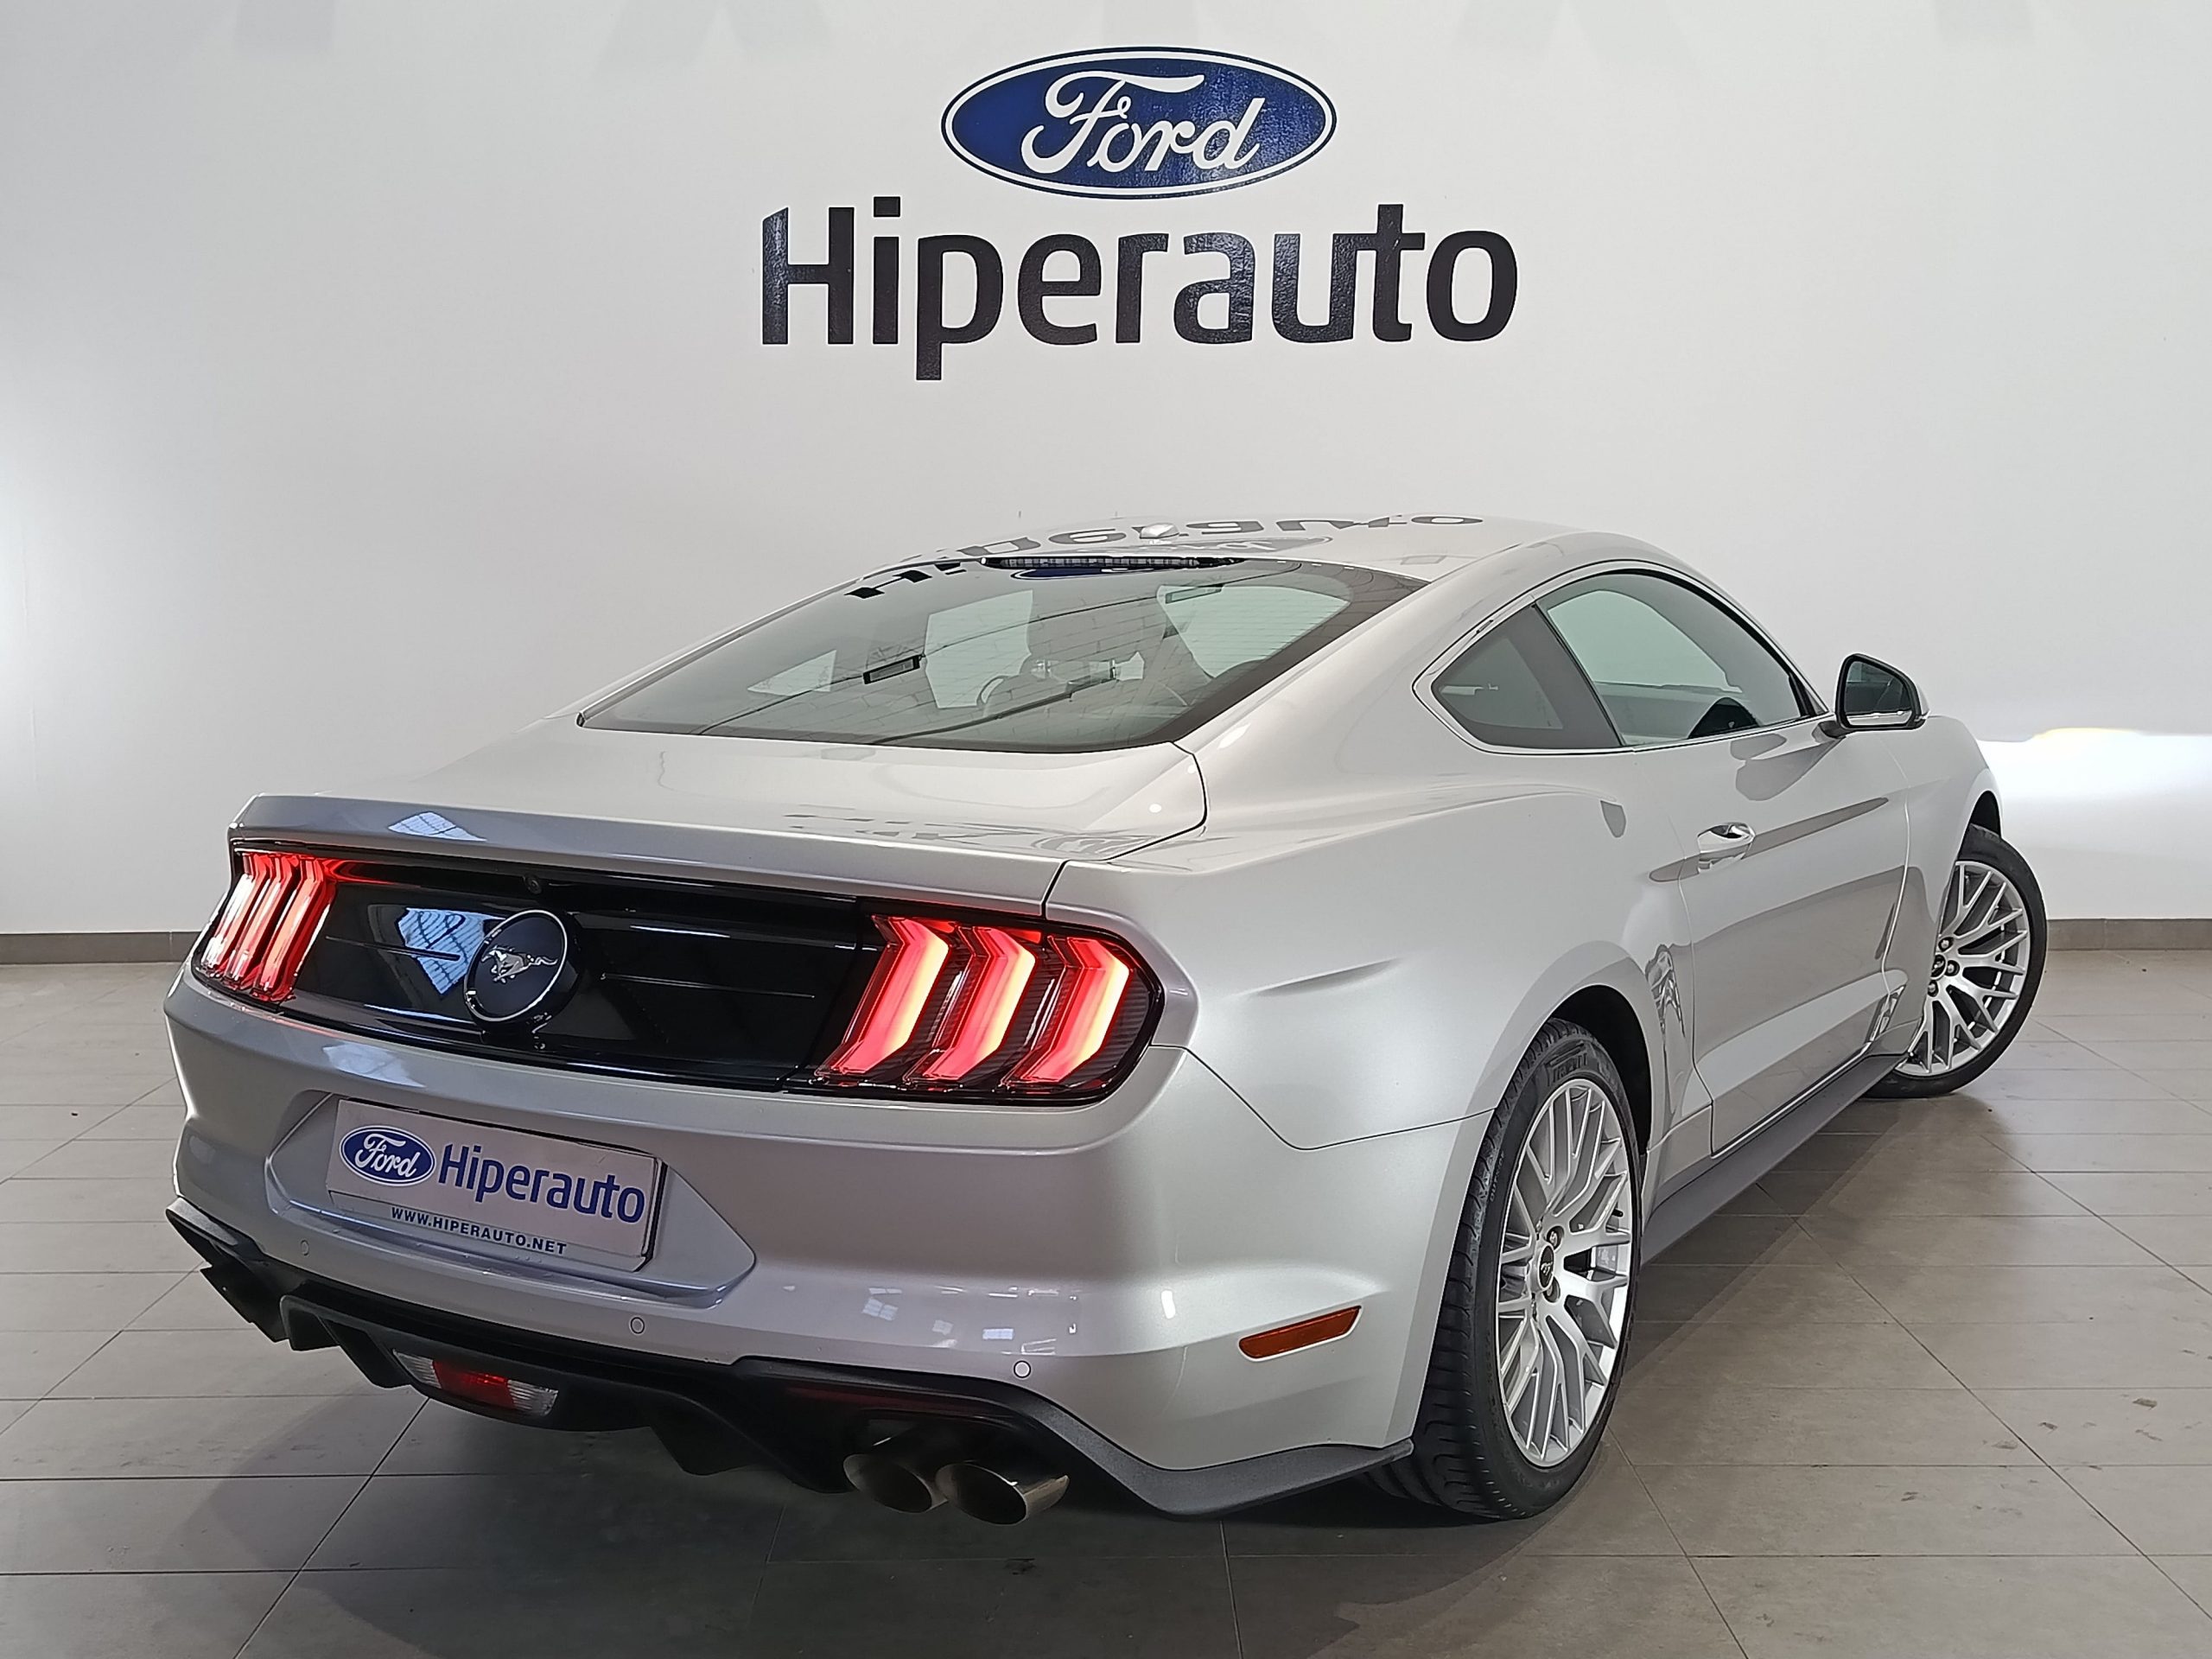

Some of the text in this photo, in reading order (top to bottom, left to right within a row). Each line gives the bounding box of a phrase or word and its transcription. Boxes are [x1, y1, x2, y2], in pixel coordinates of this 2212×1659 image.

[1021, 70, 1265, 173] Ford
[762, 196, 1518, 381] Hiperauto
[354, 1134, 646, 1224] Ford Hiperauto
[391, 1206, 567, 1255] WWW.HIPERAUTO.NET
